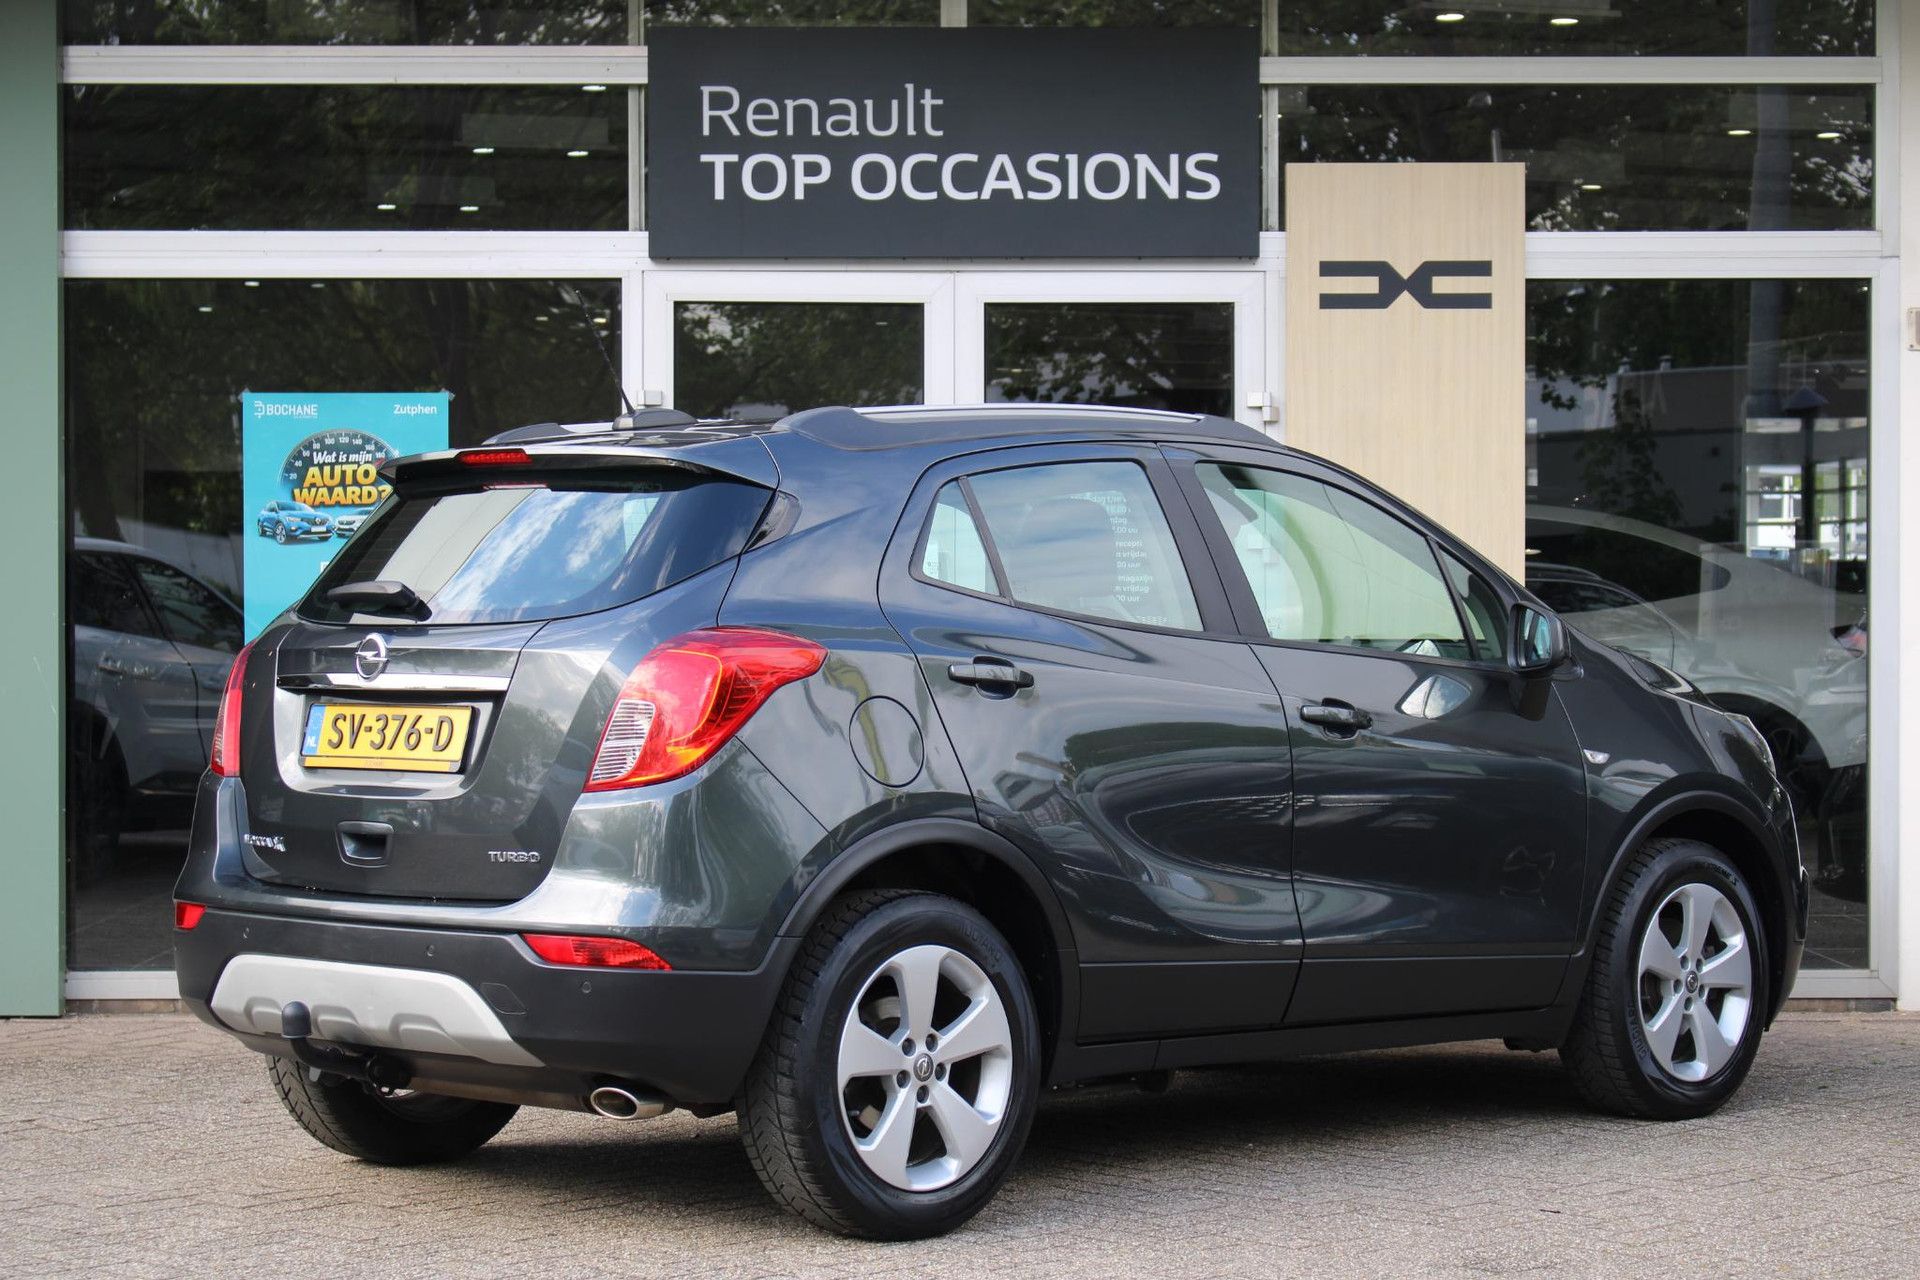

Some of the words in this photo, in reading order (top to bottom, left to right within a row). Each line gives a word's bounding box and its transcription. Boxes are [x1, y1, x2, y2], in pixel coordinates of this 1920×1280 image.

[700, 83, 944, 137] Renault
[700, 152, 832, 200] TOP
[850, 152, 1222, 201] OCCASIONS
[266, 403, 318, 416] BOCHANE
[393, 403, 437, 417] Zutphen
[294, 459, 302, 467] 40
[312, 450, 336, 464] Wat
[339, 451, 348, 463] is
[349, 450, 373, 465] mijn
[289, 472, 298, 480] 20
[302, 464, 378, 487] AUTO
[293, 484, 394, 506] WAARD?
[327, 712, 454, 752] SV-376-D
[306, 735, 317, 747] NL
[487, 850, 541, 863] TURBO
